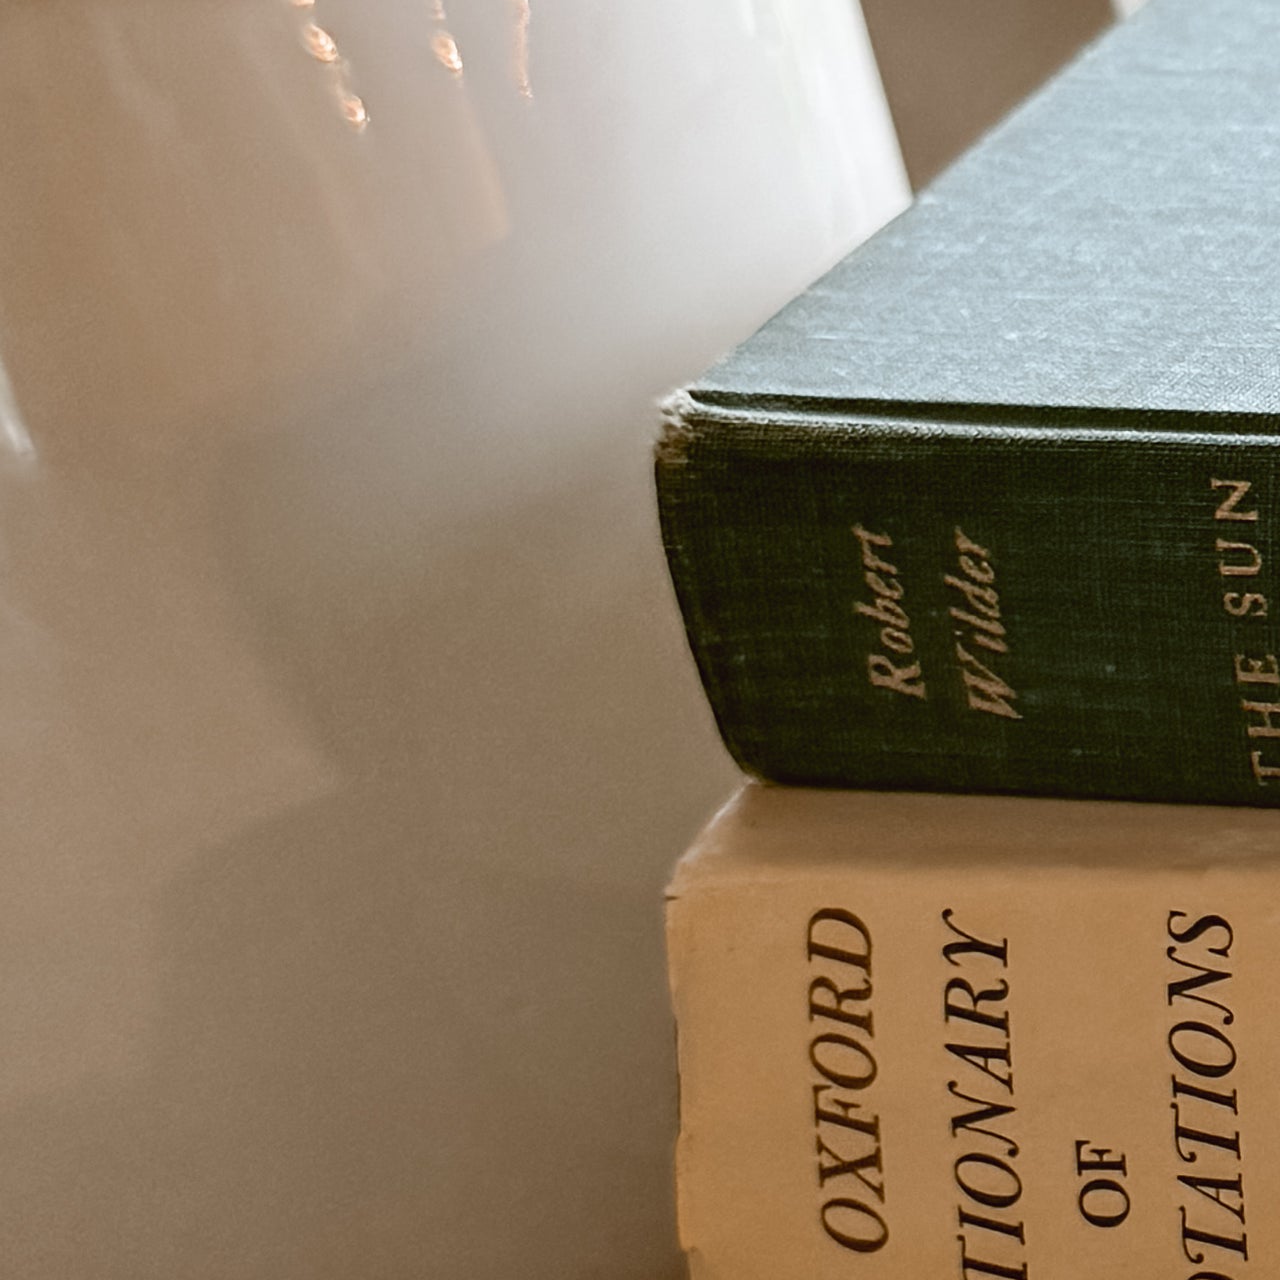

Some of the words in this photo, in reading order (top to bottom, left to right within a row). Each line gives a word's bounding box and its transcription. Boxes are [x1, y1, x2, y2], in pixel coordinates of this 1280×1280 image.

[851, 523, 926, 700] Robert
[943, 526, 1022, 720] Wilder
[1211, 477, 1269, 619] SUN
[808, 907, 890, 1253] OXFORD
[1076, 1139, 1131, 1228] OF
